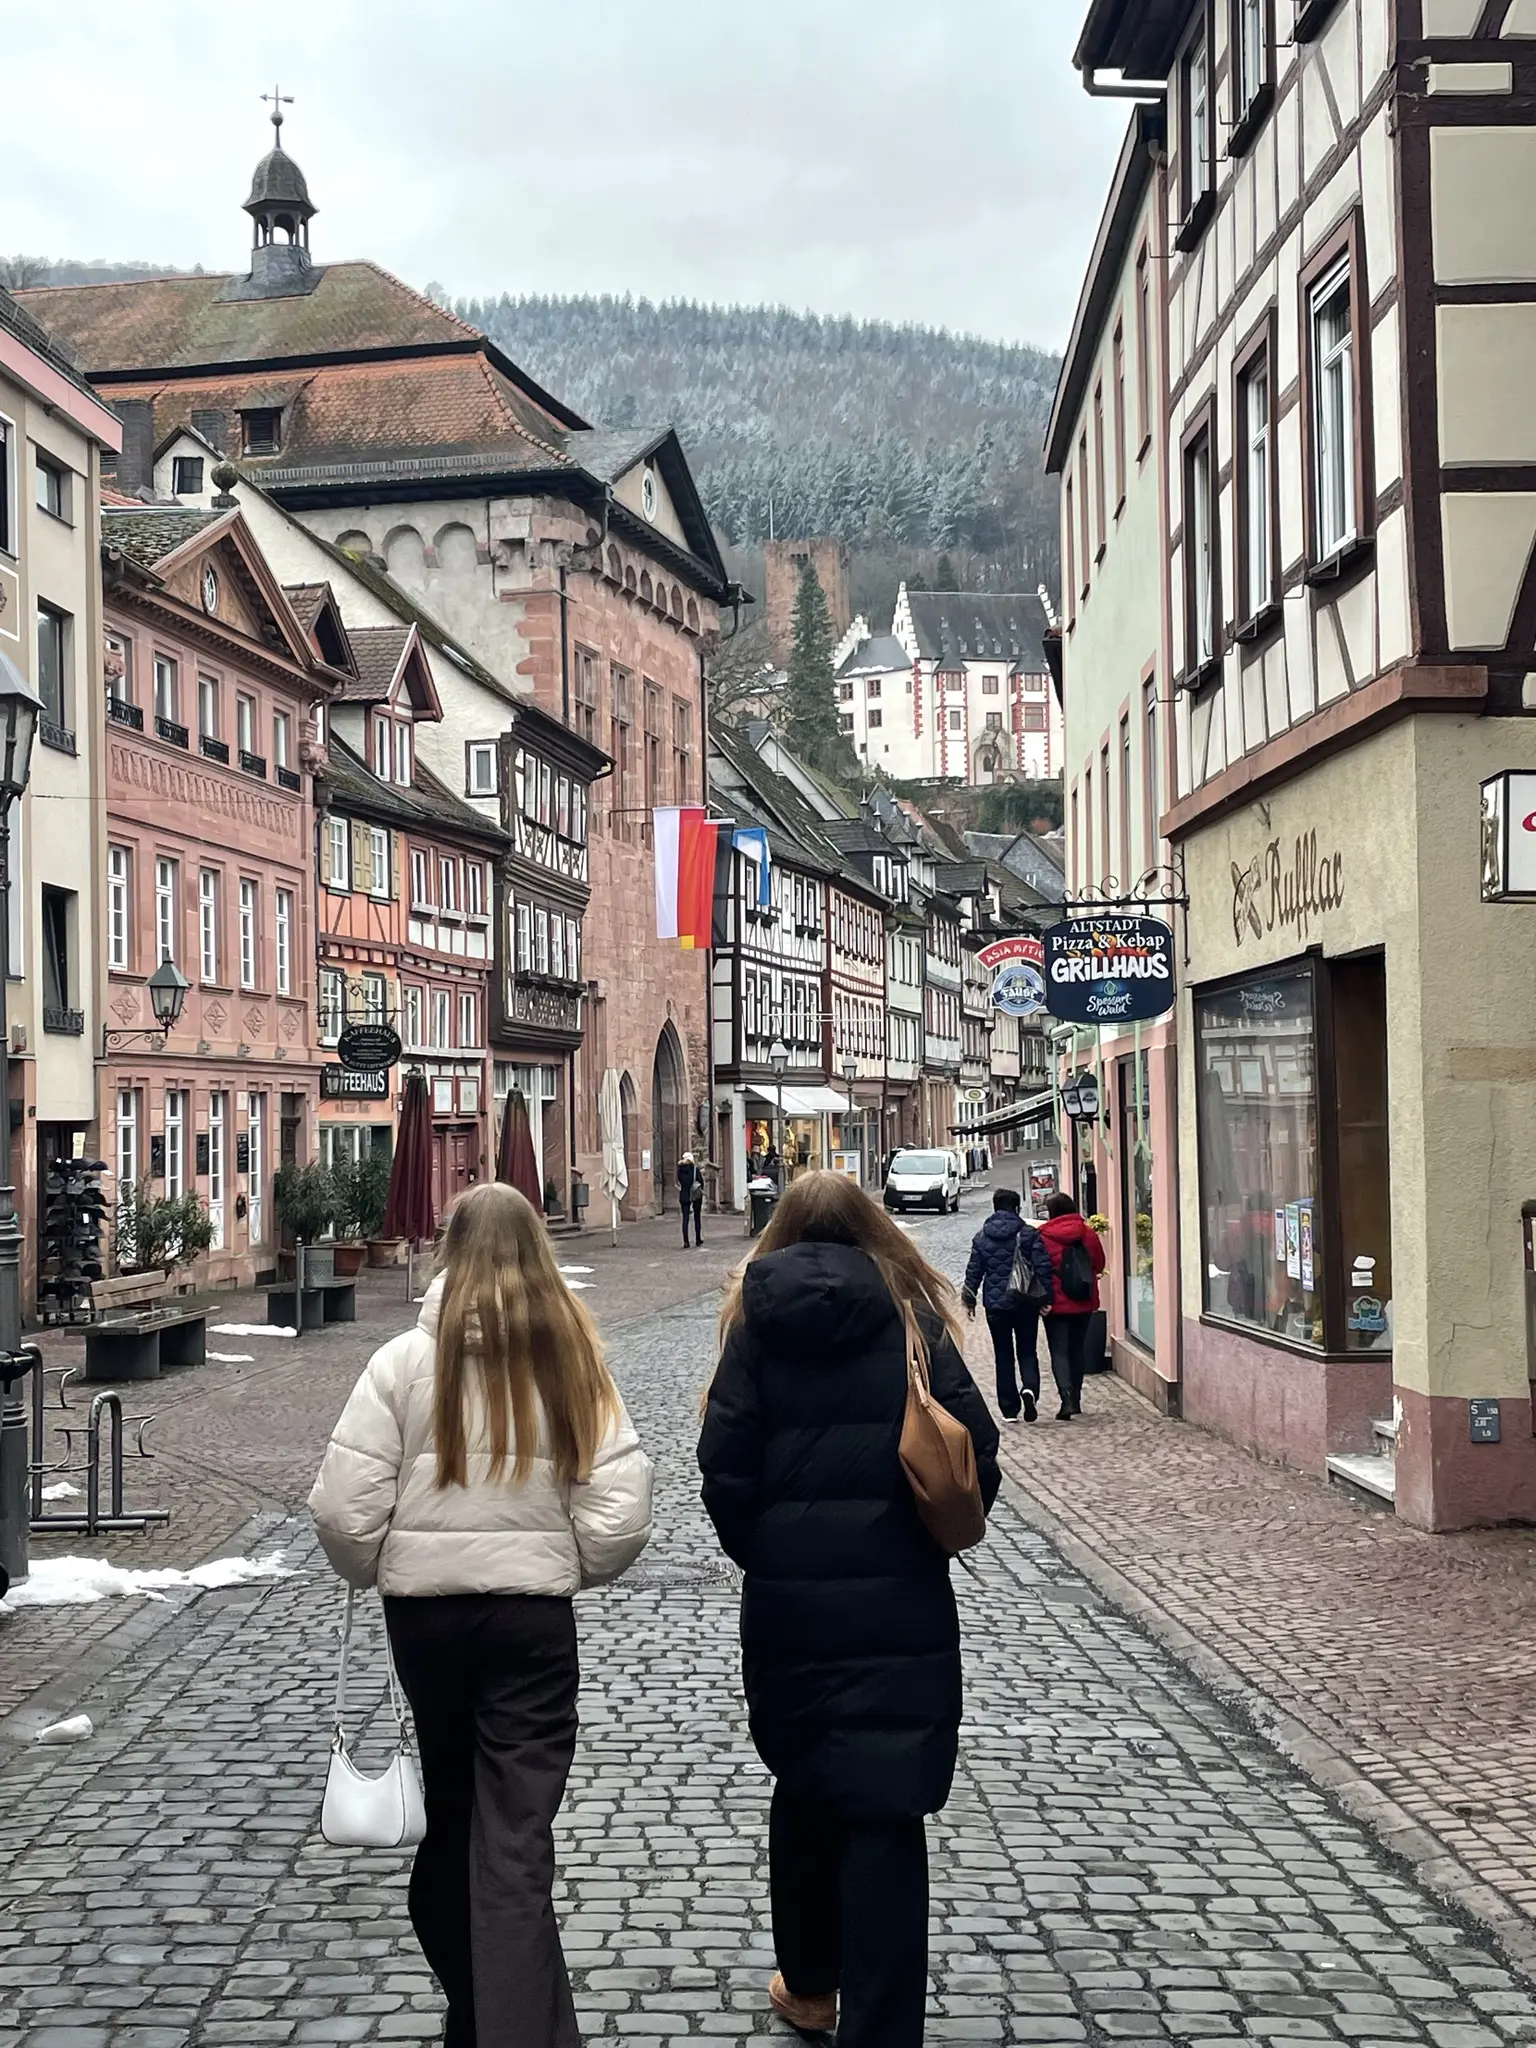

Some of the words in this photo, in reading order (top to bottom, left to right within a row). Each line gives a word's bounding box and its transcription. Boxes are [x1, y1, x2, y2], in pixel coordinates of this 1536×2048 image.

[1069, 919, 1142, 933] ALTSTADT
[1051, 936, 1094, 951] Pizza
[1098, 934, 1111, 949] &
[1115, 932, 1165, 950] Kebap
[985, 946, 1011, 963] ASIA
[343, 1026, 398, 1043] KAFFEEHAUS
[335, 1070, 385, 1092] FEEHAUS
